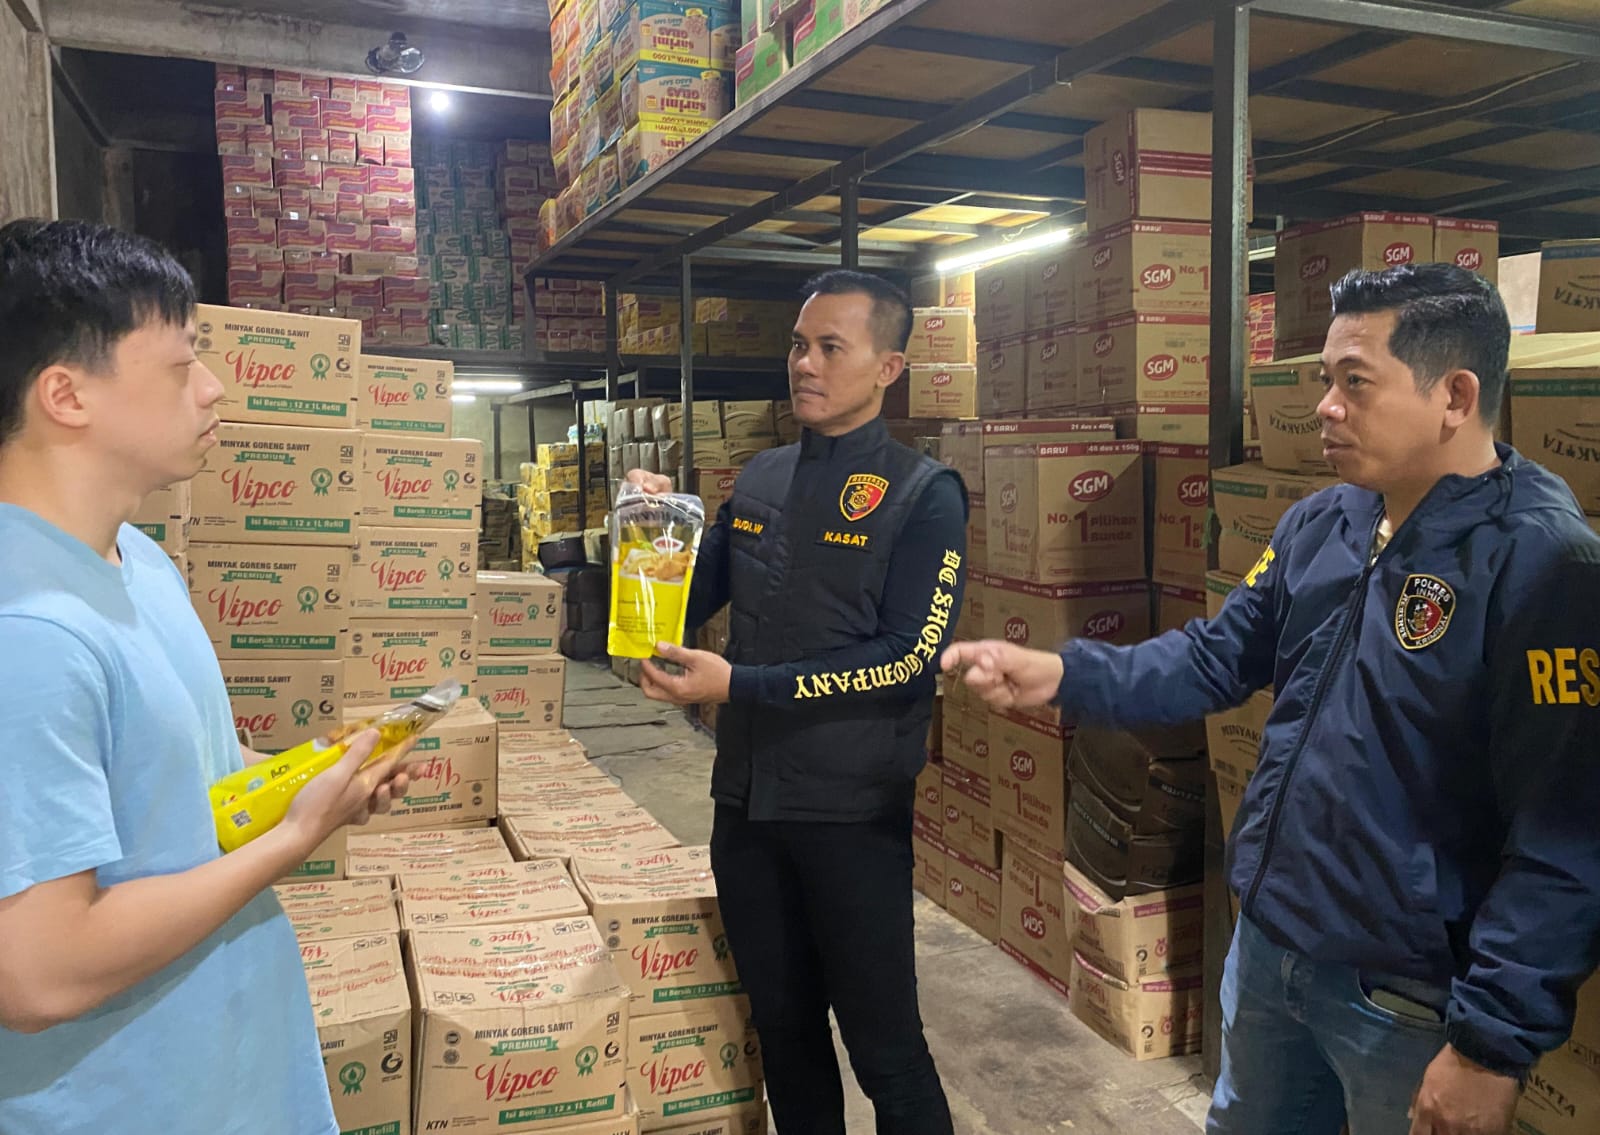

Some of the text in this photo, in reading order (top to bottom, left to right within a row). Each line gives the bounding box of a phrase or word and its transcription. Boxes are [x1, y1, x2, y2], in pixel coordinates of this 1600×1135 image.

[652, 36, 694, 50] sarimi
[660, 96, 706, 112] sarimi
[1113, 152, 1125, 181] SGM
[1094, 248, 1111, 267] SGM
[1385, 246, 1410, 262] SGM
[1457, 253, 1479, 268] SGM
[1043, 264, 1058, 280] SGM
[1143, 268, 1171, 284] SGM
[1179, 265, 1197, 274] No.
[1302, 260, 1326, 276] SGM
[225, 323, 310, 338] MINYAK GORENG SAWIT
[926, 320, 943, 329] SGM
[247, 335, 287, 345] PREMIUM
[1095, 335, 1112, 353] SGM
[1042, 344, 1057, 360] SGM
[1182, 354, 1200, 364] No.
[225, 349, 296, 389] Vipco
[1147, 359, 1174, 375] SGM
[932, 375, 950, 384] SGM
[368, 383, 410, 407] Vipco
[322, 404, 341, 412] Refill
[220, 440, 310, 451] MINYAK GORENG SAWIT
[400, 449, 424, 457] GORENG
[1040, 447, 1068, 455] BARU!
[244, 452, 286, 461] PREMIUM
[221, 466, 298, 508] Vipco
[376, 467, 432, 500] Vipco
[1073, 475, 1108, 496] SGM
[1180, 481, 1208, 499] SGM
[1001, 487, 1017, 507] SGM
[251, 518, 261, 526] Isi
[263, 519, 288, 527] Bersih
[324, 520, 344, 528] Refill
[1047, 510, 1088, 544] No. 1
[1159, 513, 1178, 525] No.
[1180, 514, 1191, 547] 1
[823, 531, 869, 547] KASAT
[207, 560, 297, 571] MINYAK GORENG SAWIT
[231, 571, 273, 579] PREMIUM
[370, 558, 427, 592] Vipco
[1414, 578, 1450, 602] POLRES
[1416, 588, 1441, 604] INHIL
[208, 585, 284, 627] Vipco
[489, 606, 525, 627] Vipco
[1087, 614, 1119, 635] SGM
[913, 587, 954, 663] SHOE
[1006, 623, 1026, 640] SGM
[1415, 615, 1448, 646] KRIMINAL
[309, 637, 329, 645] Refill
[371, 649, 429, 682] Vipco
[794, 653, 923, 699] COMPANY
[1526, 647, 1600, 708] RES
[343, 691, 358, 700] KTN
[494, 687, 530, 708] Vipco
[474, 736, 490, 745] KTN
[1221, 725, 1262, 743] MINYAK
[1012, 755, 1032, 773] SGM
[946, 808, 958, 818] SGM
[950, 880, 962, 893] SGM
[632, 915, 659, 925] MINYAK
[661, 914, 689, 923] GORENG
[1023, 914, 1043, 935] SGM
[489, 931, 540, 944] Vipco
[653, 925, 691, 935] PREMIUM
[631, 940, 699, 981] Vipco
[491, 990, 545, 1003] Vipco
[475, 1021, 575, 1040] MINYAK GORENG SAWIT
[639, 1024, 719, 1042] MINYAK GORENG SAWIT
[320, 1039, 345, 1050] SAWIT
[501, 1039, 548, 1051] PREMIUM
[660, 1037, 697, 1048] PREMIUM
[475, 1058, 560, 1102] Vipco
[640, 1055, 707, 1094] Vipco
[505, 1111, 516, 1119] Isi
[518, 1108, 547, 1118] Bersih
[554, 1105, 564, 1114] 12
[585, 1098, 608, 1110] Refill
[426, 1119, 448, 1131] KTN
